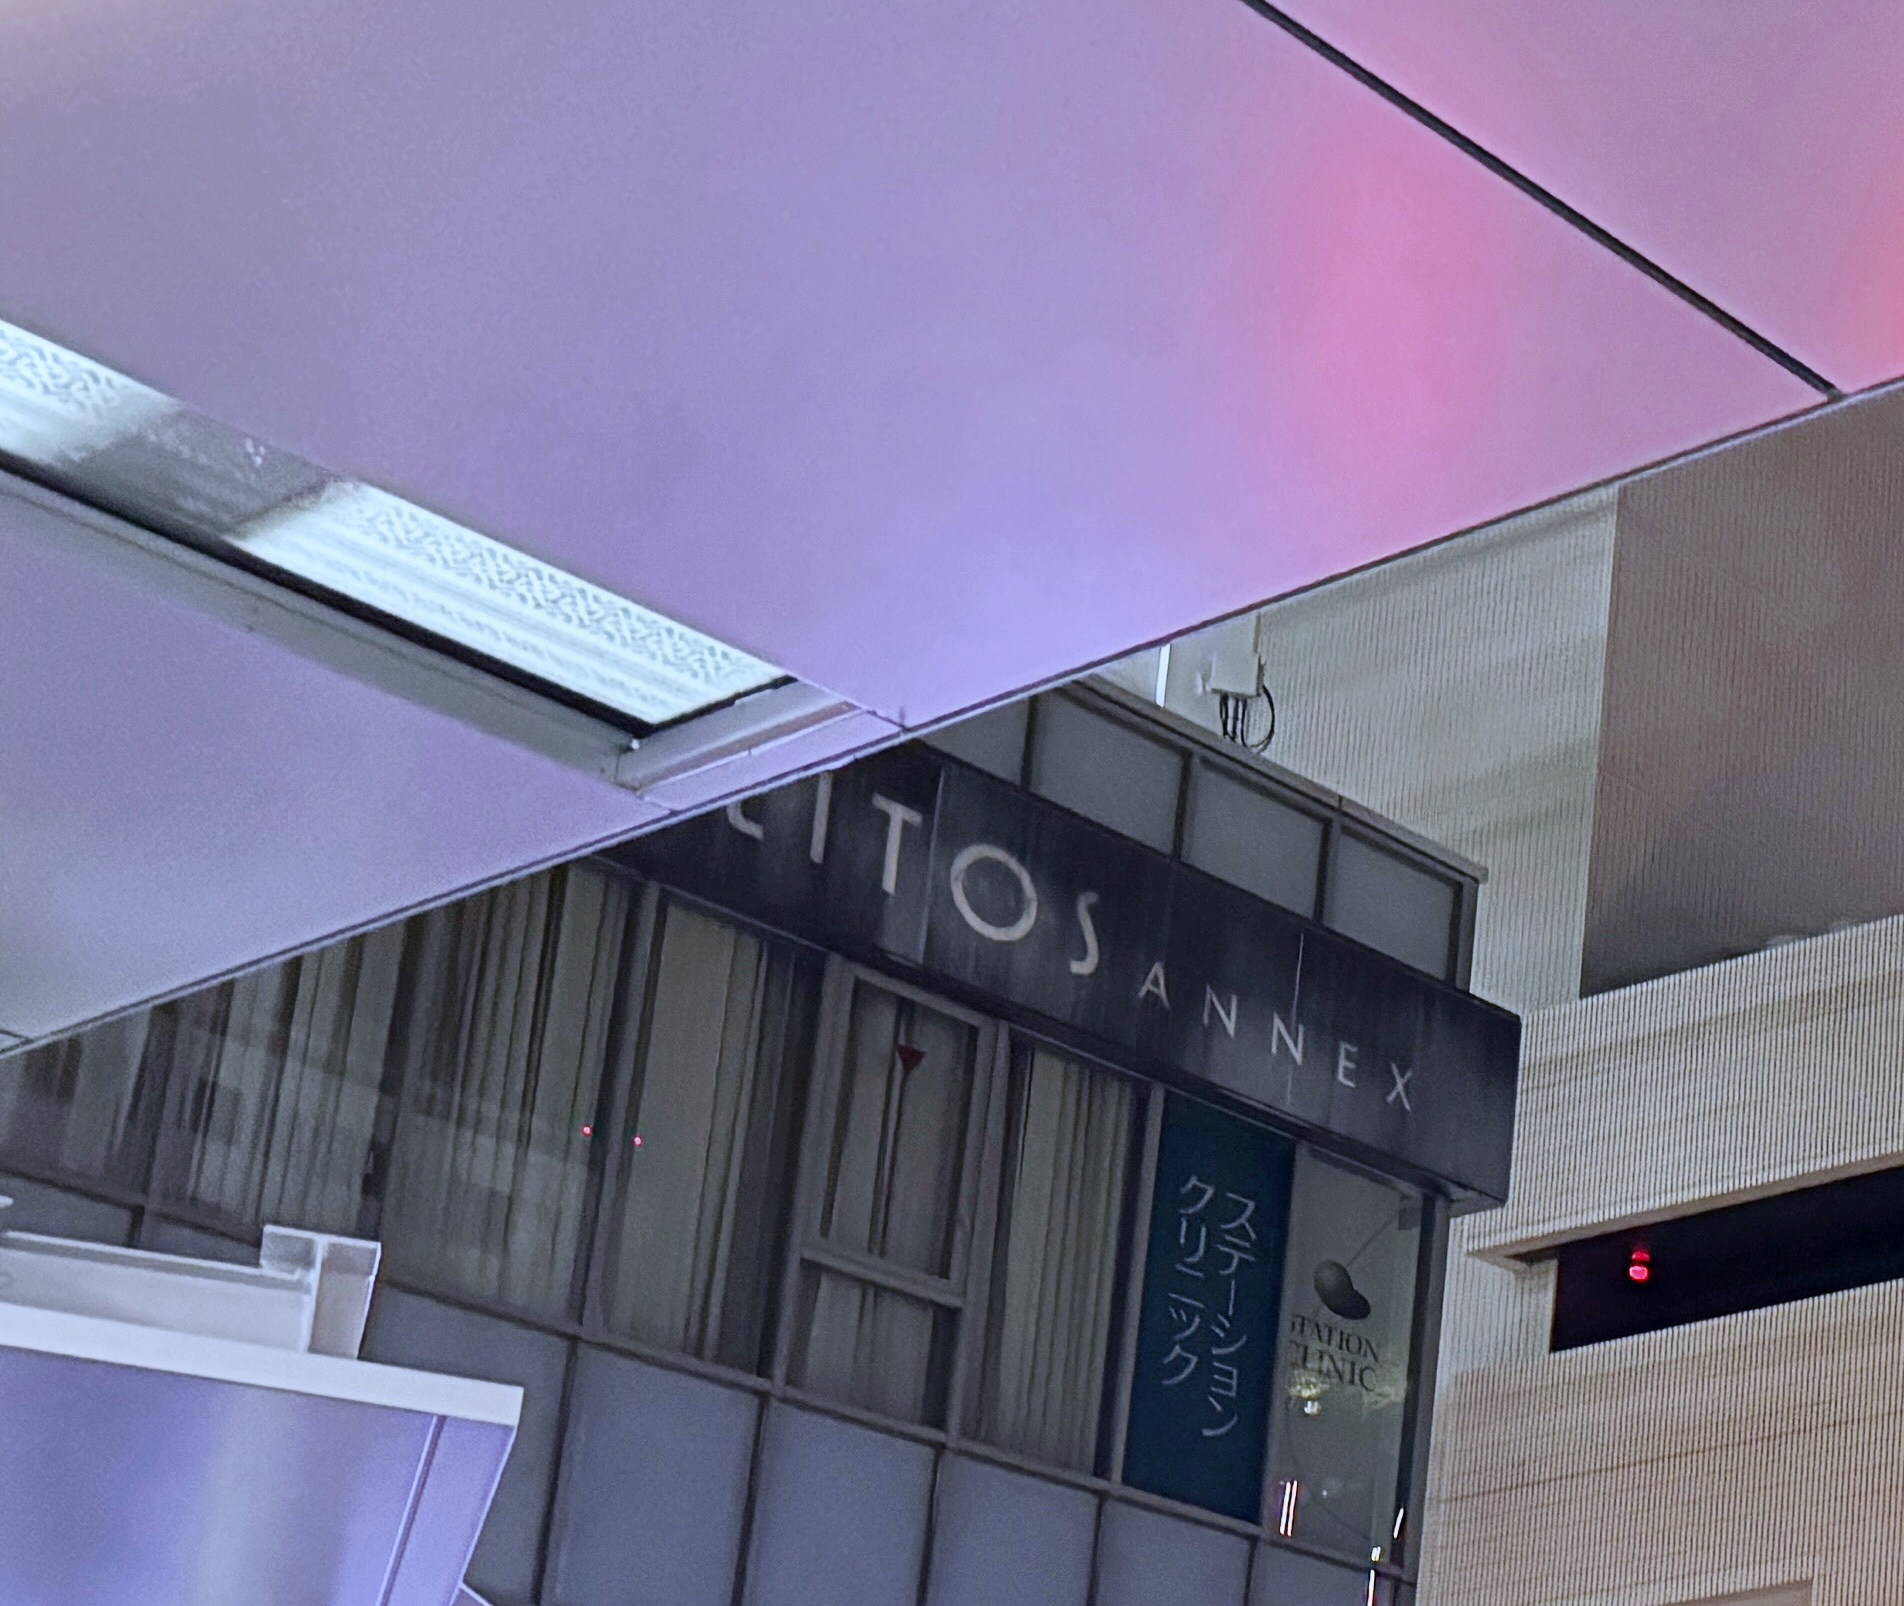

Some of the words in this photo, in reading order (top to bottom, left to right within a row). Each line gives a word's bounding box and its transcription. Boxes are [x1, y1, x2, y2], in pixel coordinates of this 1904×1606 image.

[1137, 961, 1414, 1111] ANNEX
[1162, 1175, 1215, 1386] クリニック
[1202, 1191, 1257, 1437] ステーション
